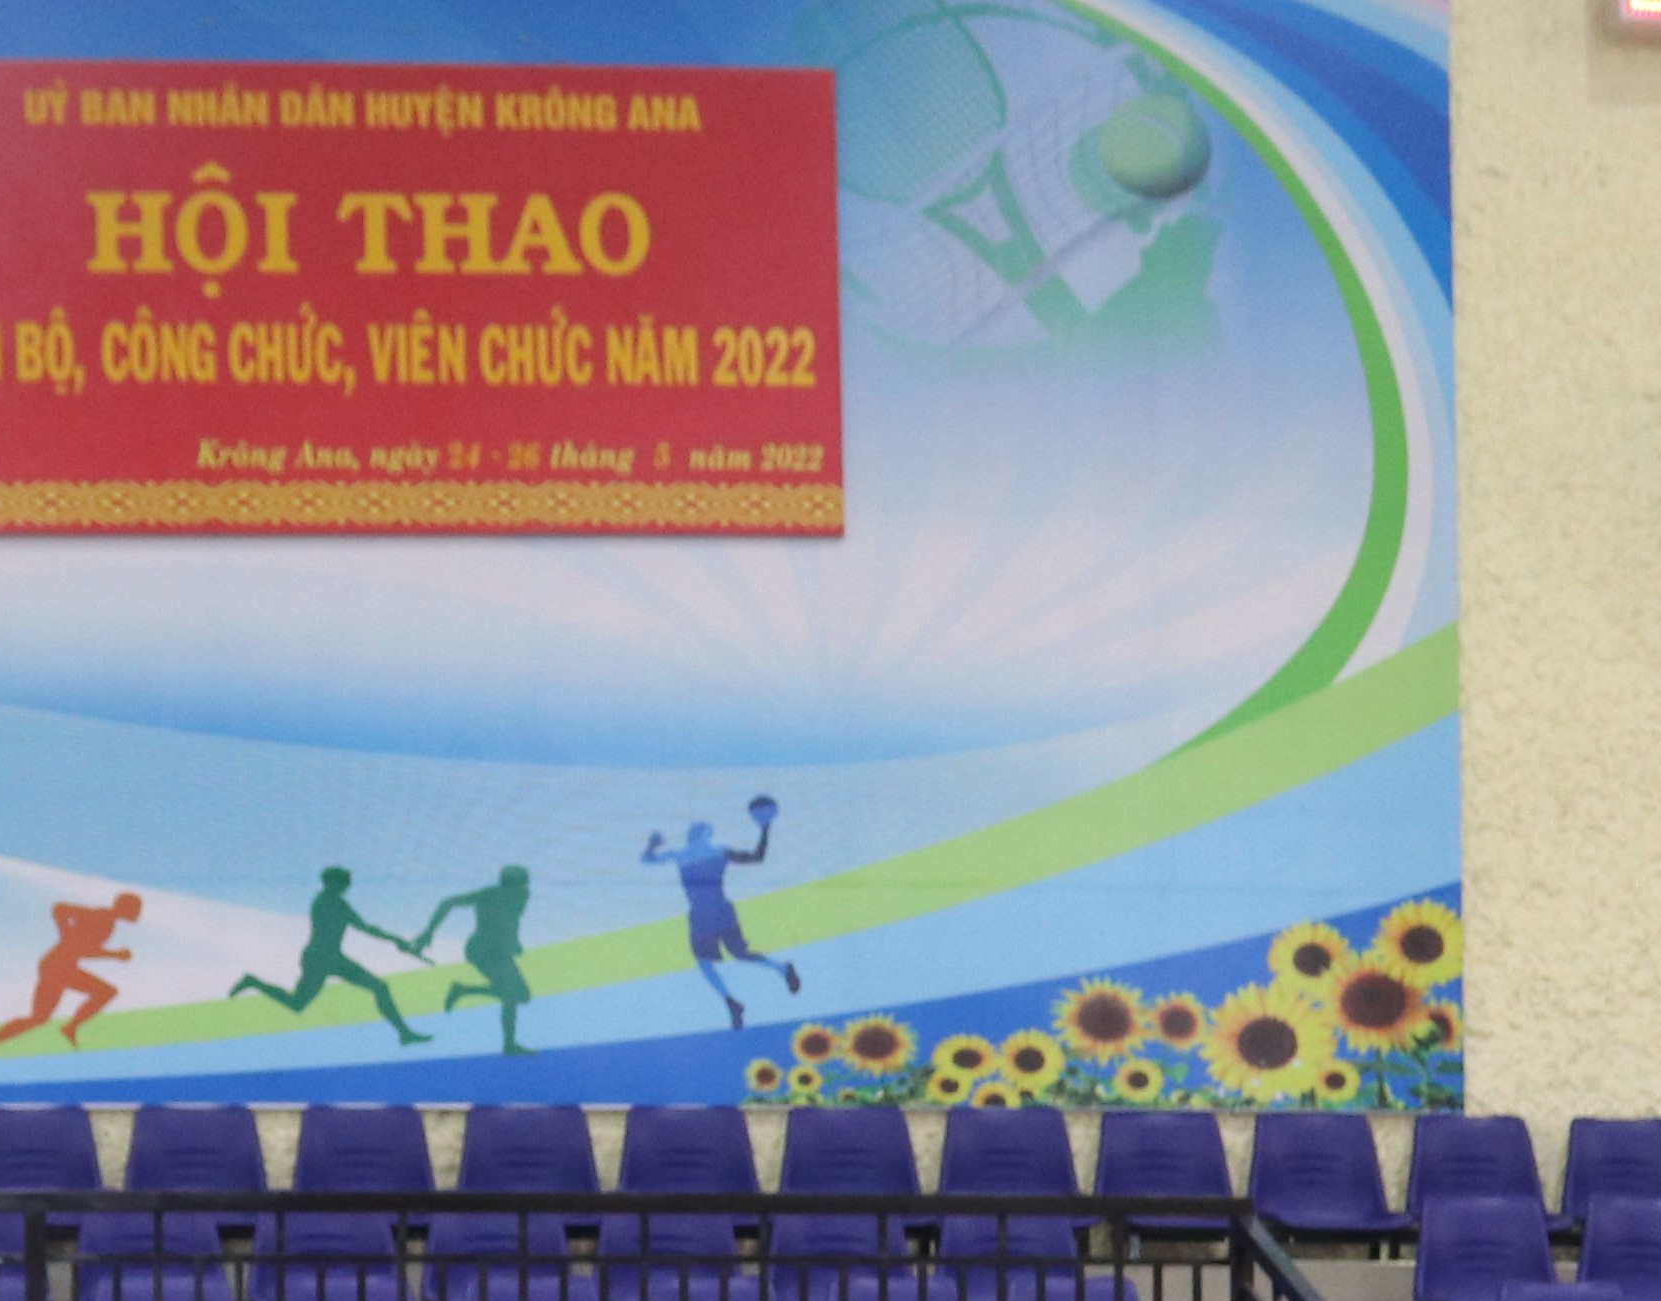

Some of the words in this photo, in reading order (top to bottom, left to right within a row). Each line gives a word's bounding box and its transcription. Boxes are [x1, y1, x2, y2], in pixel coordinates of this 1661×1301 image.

[80, 88, 155, 127] BAN
[166, 80, 269, 128] NHÂN
[279, 80, 355, 128] DÂN
[365, 83, 484, 138] HUYỆN
[495, 84, 618, 131] KRÔNG
[627, 95, 701, 132] ANA
[86, 161, 298, 298] HỘI
[338, 191, 652, 277] THAO
[15, 306, 86, 396] BỘ,
[100, 304, 218, 384] CÔNG
[227, 302, 356, 396] CHỨC,
[367, 308, 469, 385] VIÊN
[478, 304, 593, 386] CHỨC
[606, 313, 701, 387] NĂM
[711, 325, 816, 388] 2022
[550, 440, 636, 475] tháng
[689, 442, 753, 471] năm
[761, 444, 826, 473] 2022
